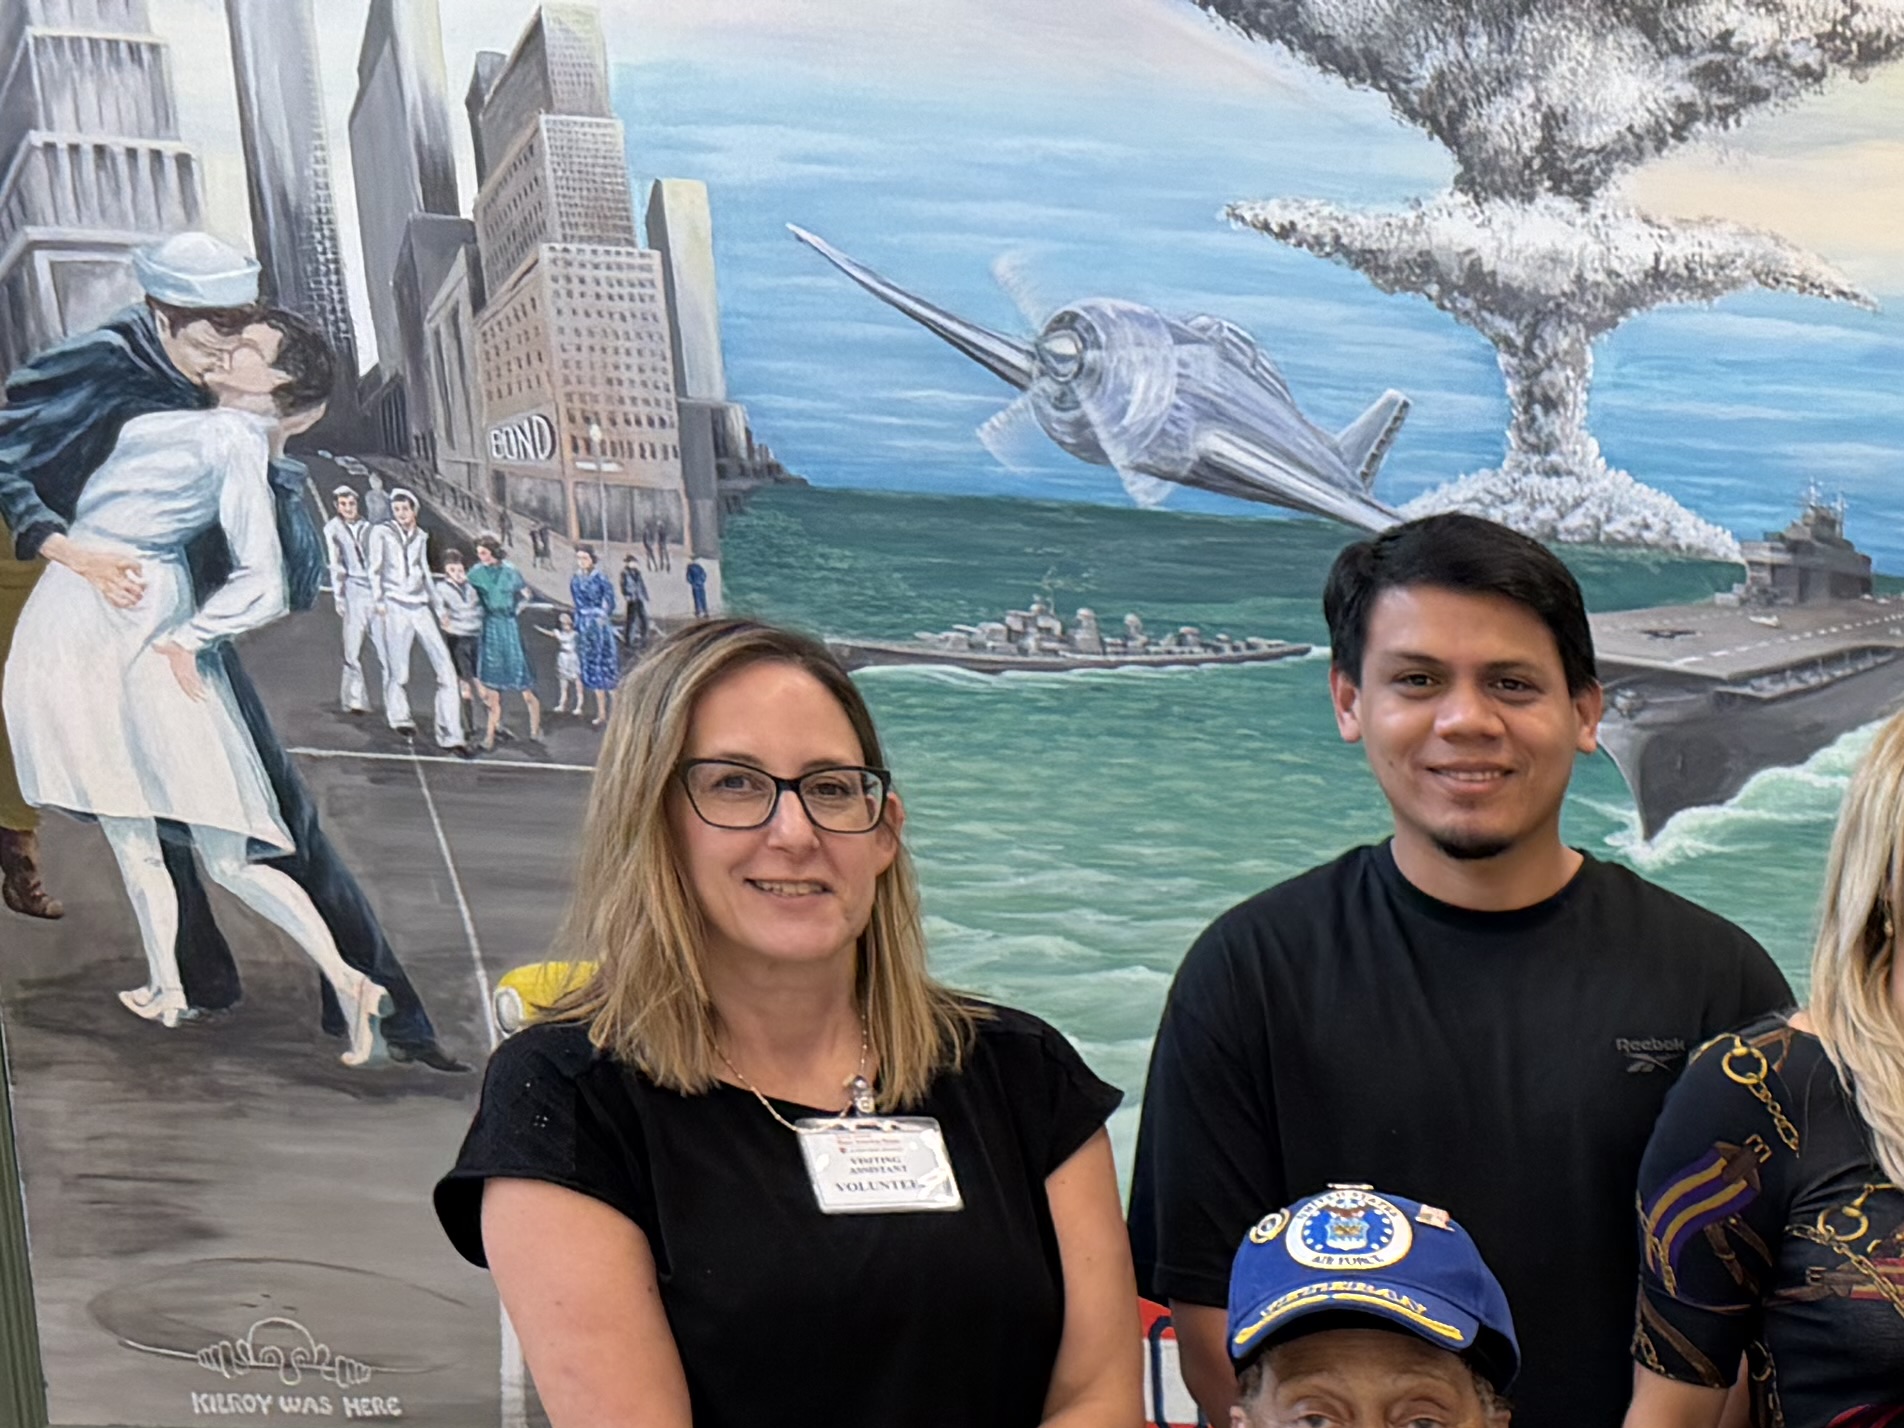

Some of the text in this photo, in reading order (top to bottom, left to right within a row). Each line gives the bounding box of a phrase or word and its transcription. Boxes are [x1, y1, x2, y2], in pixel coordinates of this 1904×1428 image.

[490, 414, 552, 460] BOND
[1615, 1037, 1686, 1053] Reebok
[835, 1179, 925, 1193] VOLUNTEE
[191, 1391, 402, 1418] KILROY WAS HERE
